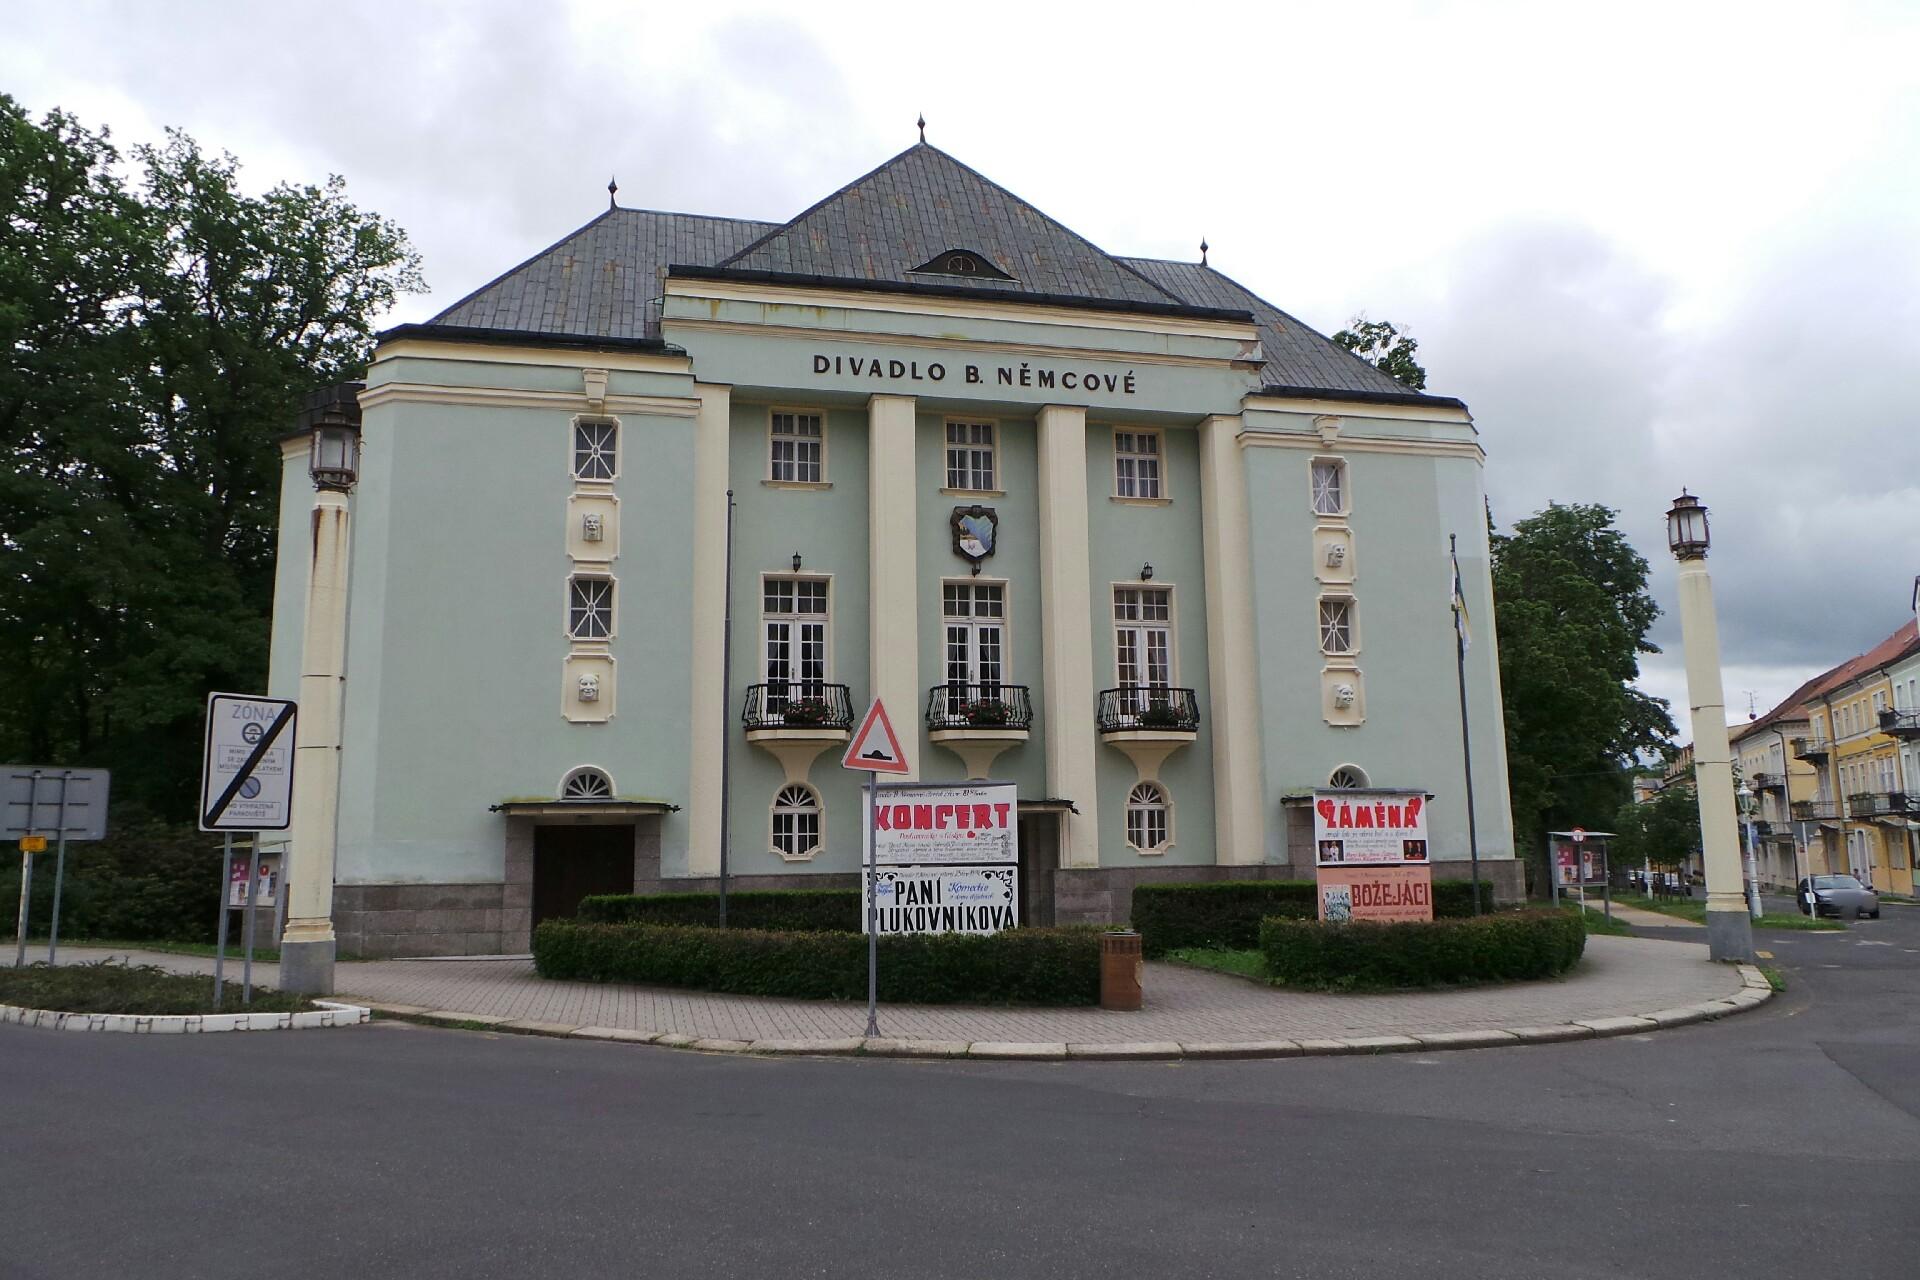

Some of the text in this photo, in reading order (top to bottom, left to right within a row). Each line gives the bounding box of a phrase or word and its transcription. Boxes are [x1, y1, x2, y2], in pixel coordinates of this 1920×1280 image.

[813, 354, 1136, 394] DIVADLO B. NĚMCOVÉ
[232, 702, 276, 721] ZÓNA
[874, 803, 1011, 831] KONCERT
[1326, 801, 1418, 828] ZÁMĚNA
[895, 877, 942, 905] PANÍ
[1351, 880, 1429, 907] BOŽEJÁCI
